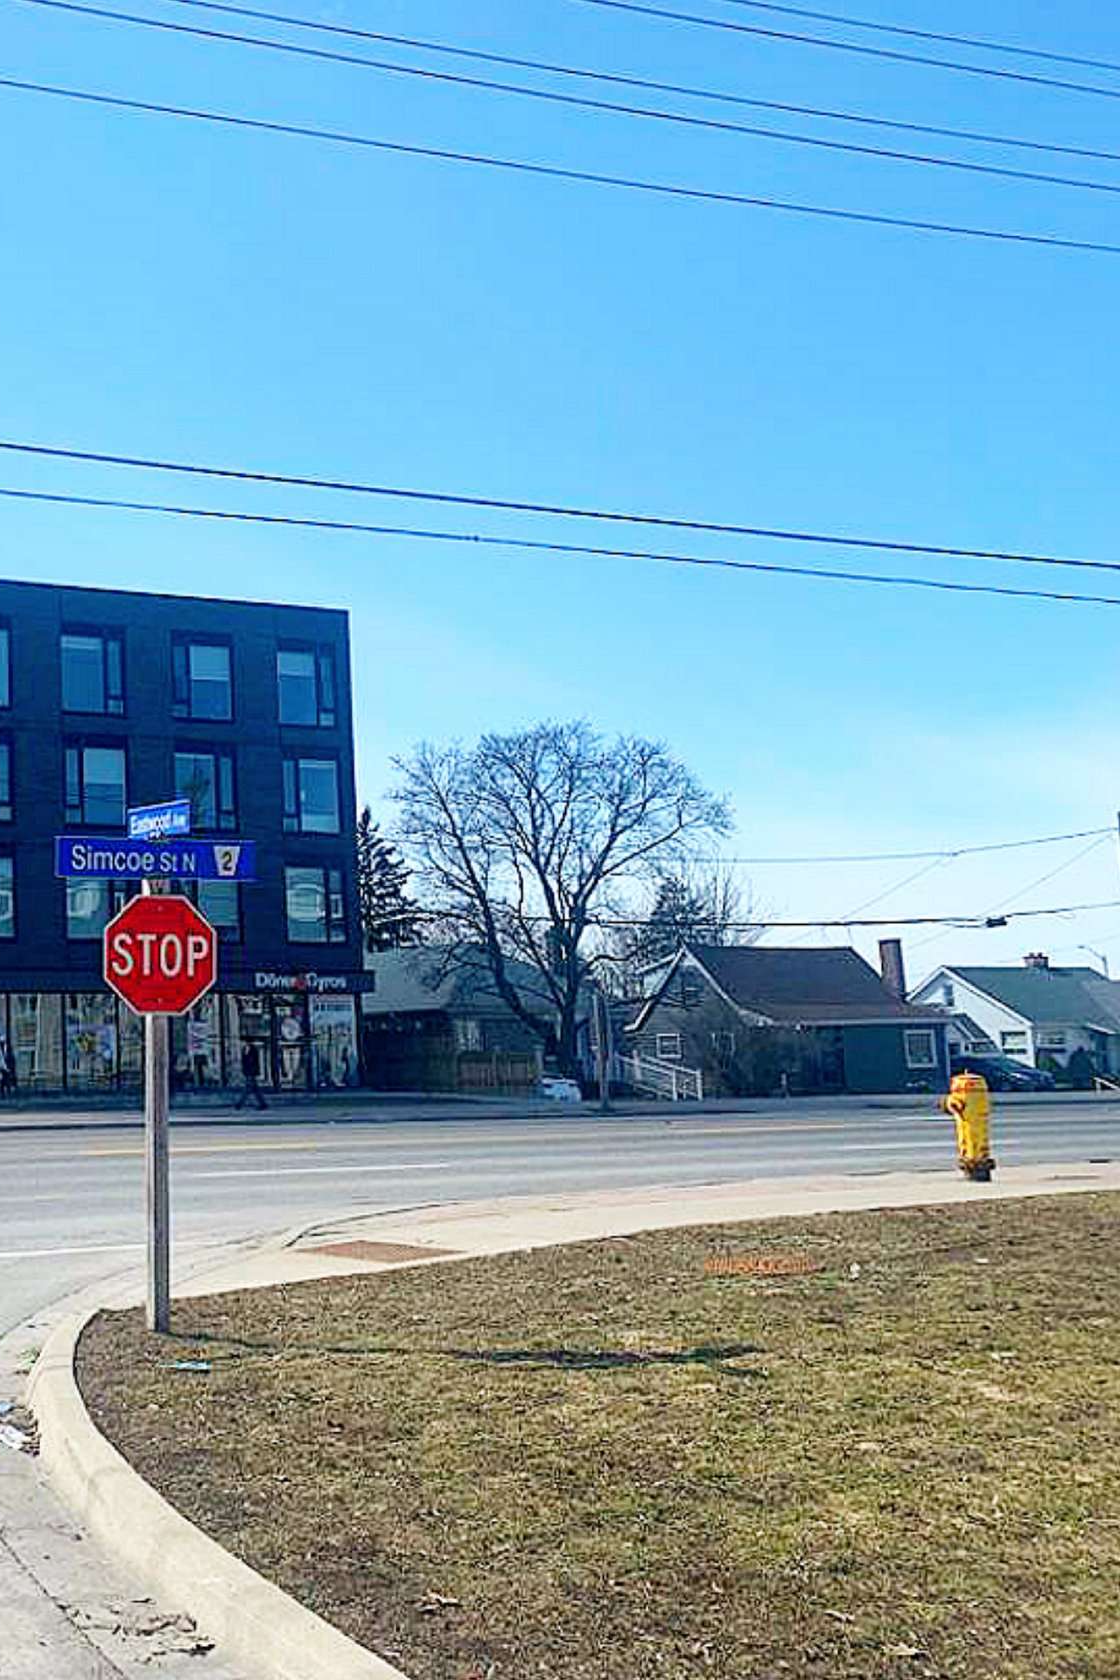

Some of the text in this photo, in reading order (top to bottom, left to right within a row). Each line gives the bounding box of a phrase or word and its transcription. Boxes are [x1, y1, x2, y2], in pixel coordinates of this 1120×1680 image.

[71, 844, 233, 872] Simcoe St N 2
[111, 932, 209, 977] STOP
